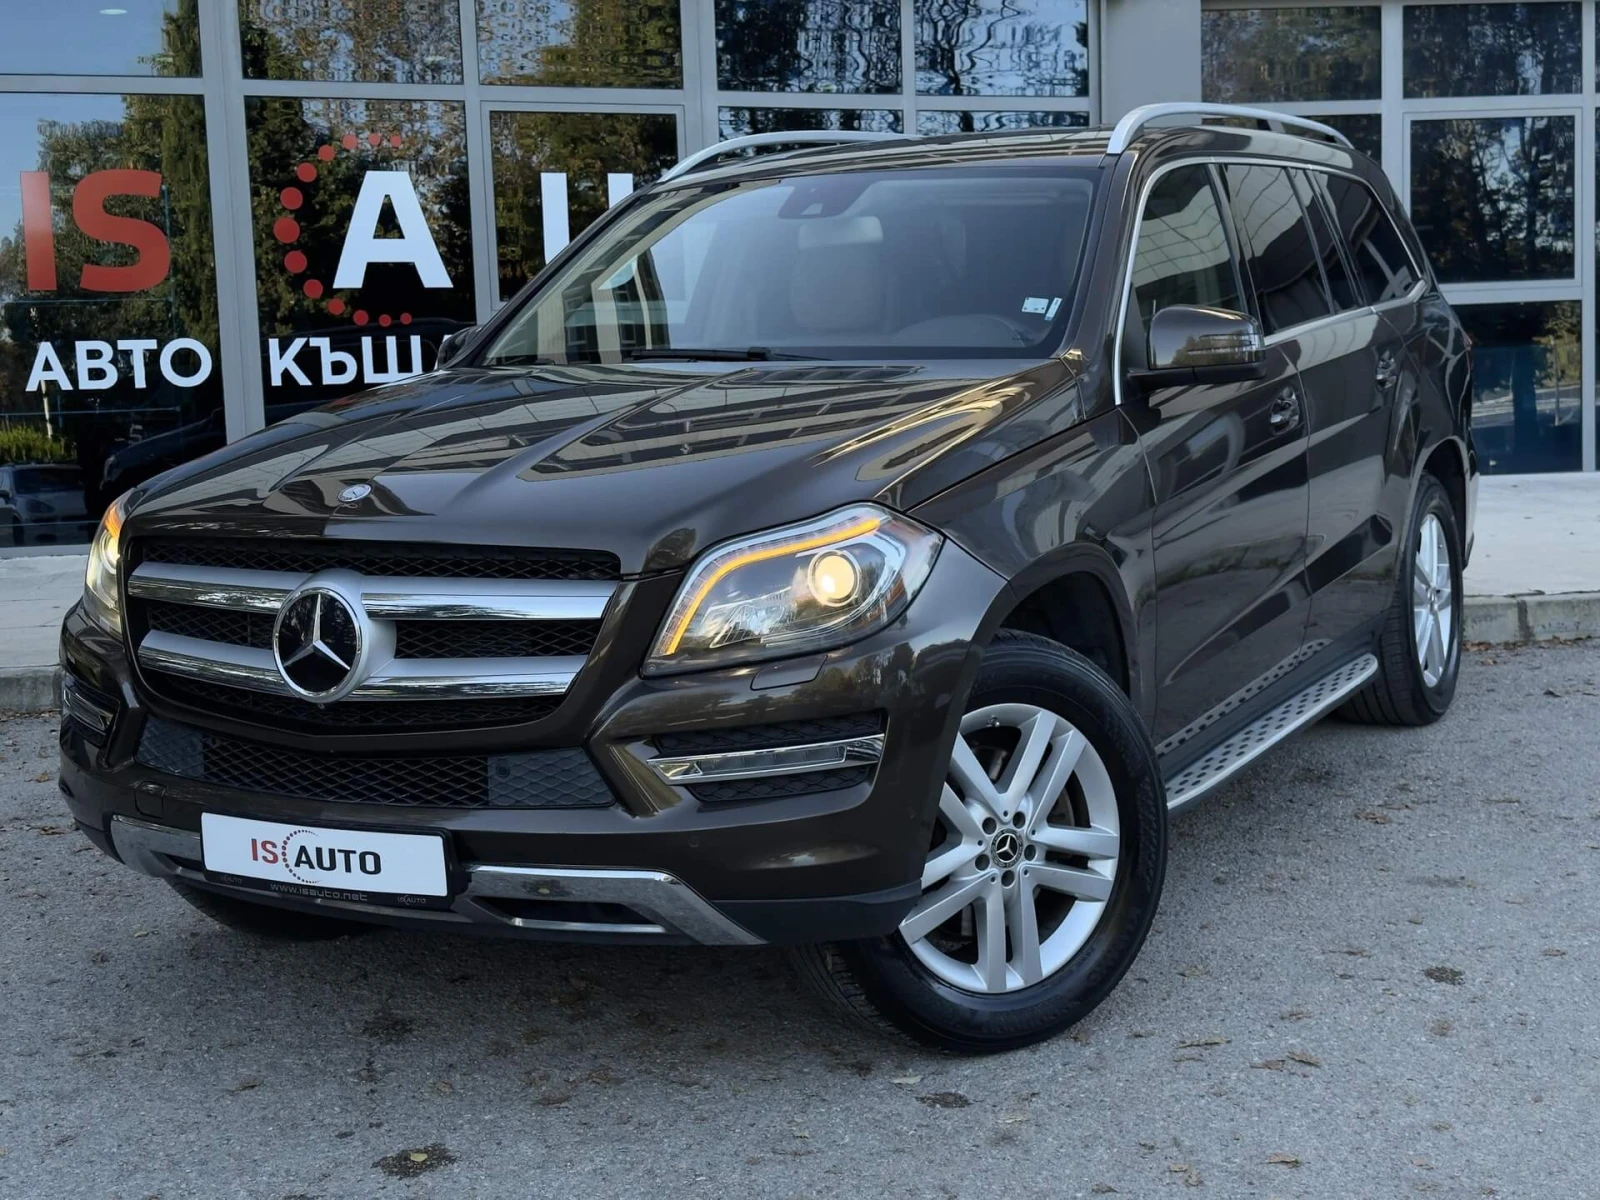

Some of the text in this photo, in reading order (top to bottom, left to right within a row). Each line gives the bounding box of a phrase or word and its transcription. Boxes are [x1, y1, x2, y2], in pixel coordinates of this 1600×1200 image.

[20, 169, 171, 293] IS
[26, 338, 212, 392] АВТО
[270, 883, 368, 901] www.isauto.net
